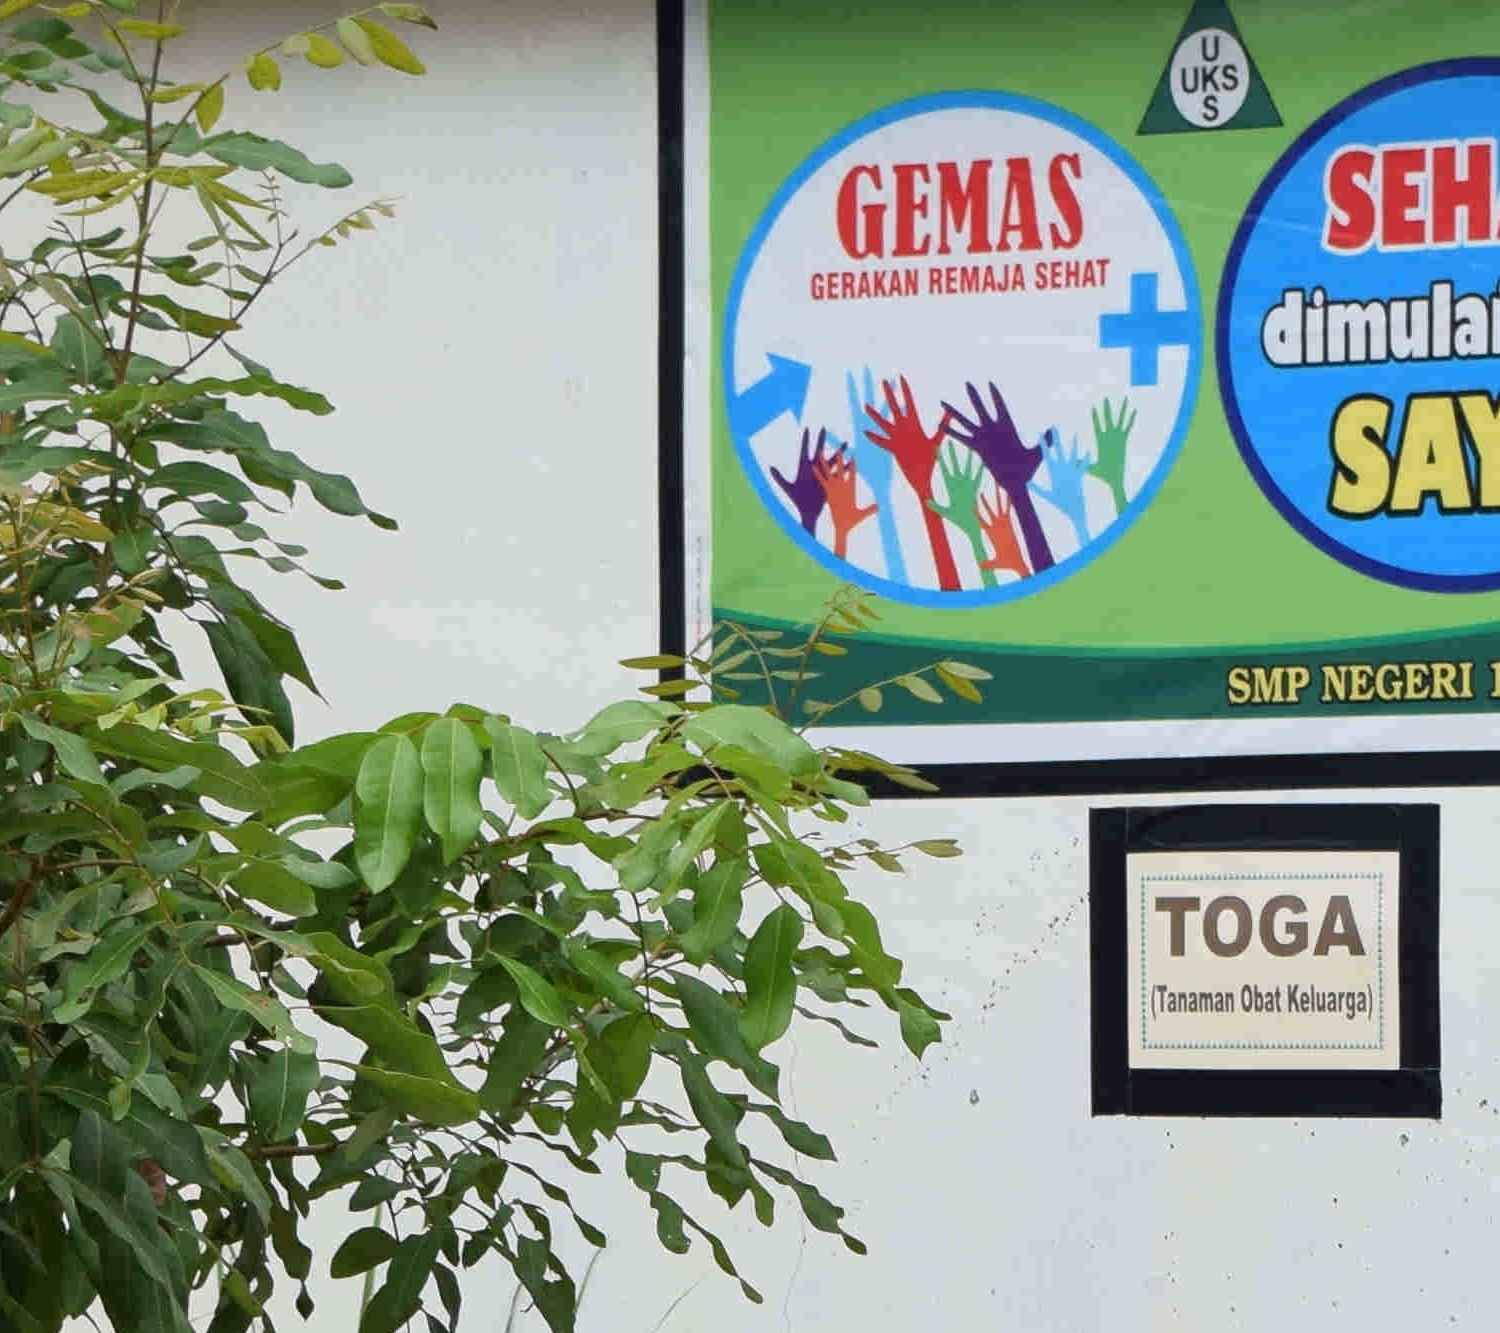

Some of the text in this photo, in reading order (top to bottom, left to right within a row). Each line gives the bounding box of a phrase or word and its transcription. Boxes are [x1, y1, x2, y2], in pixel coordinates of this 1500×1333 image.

[1201, 36, 1220, 62] U
[1181, 64, 1239, 93] UKS
[1202, 95, 1219, 121] S
[836, 153, 1084, 260] GEMAS
[811, 259, 1110, 300] GERAKAN REMAJA SEHAT
[1227, 665, 1310, 705] SMP
[1321, 661, 1474, 702] NEGERI
[1155, 895, 1366, 957] TOGA
[1151, 984, 1373, 1021] (Tanaman Obat Keluarga)
